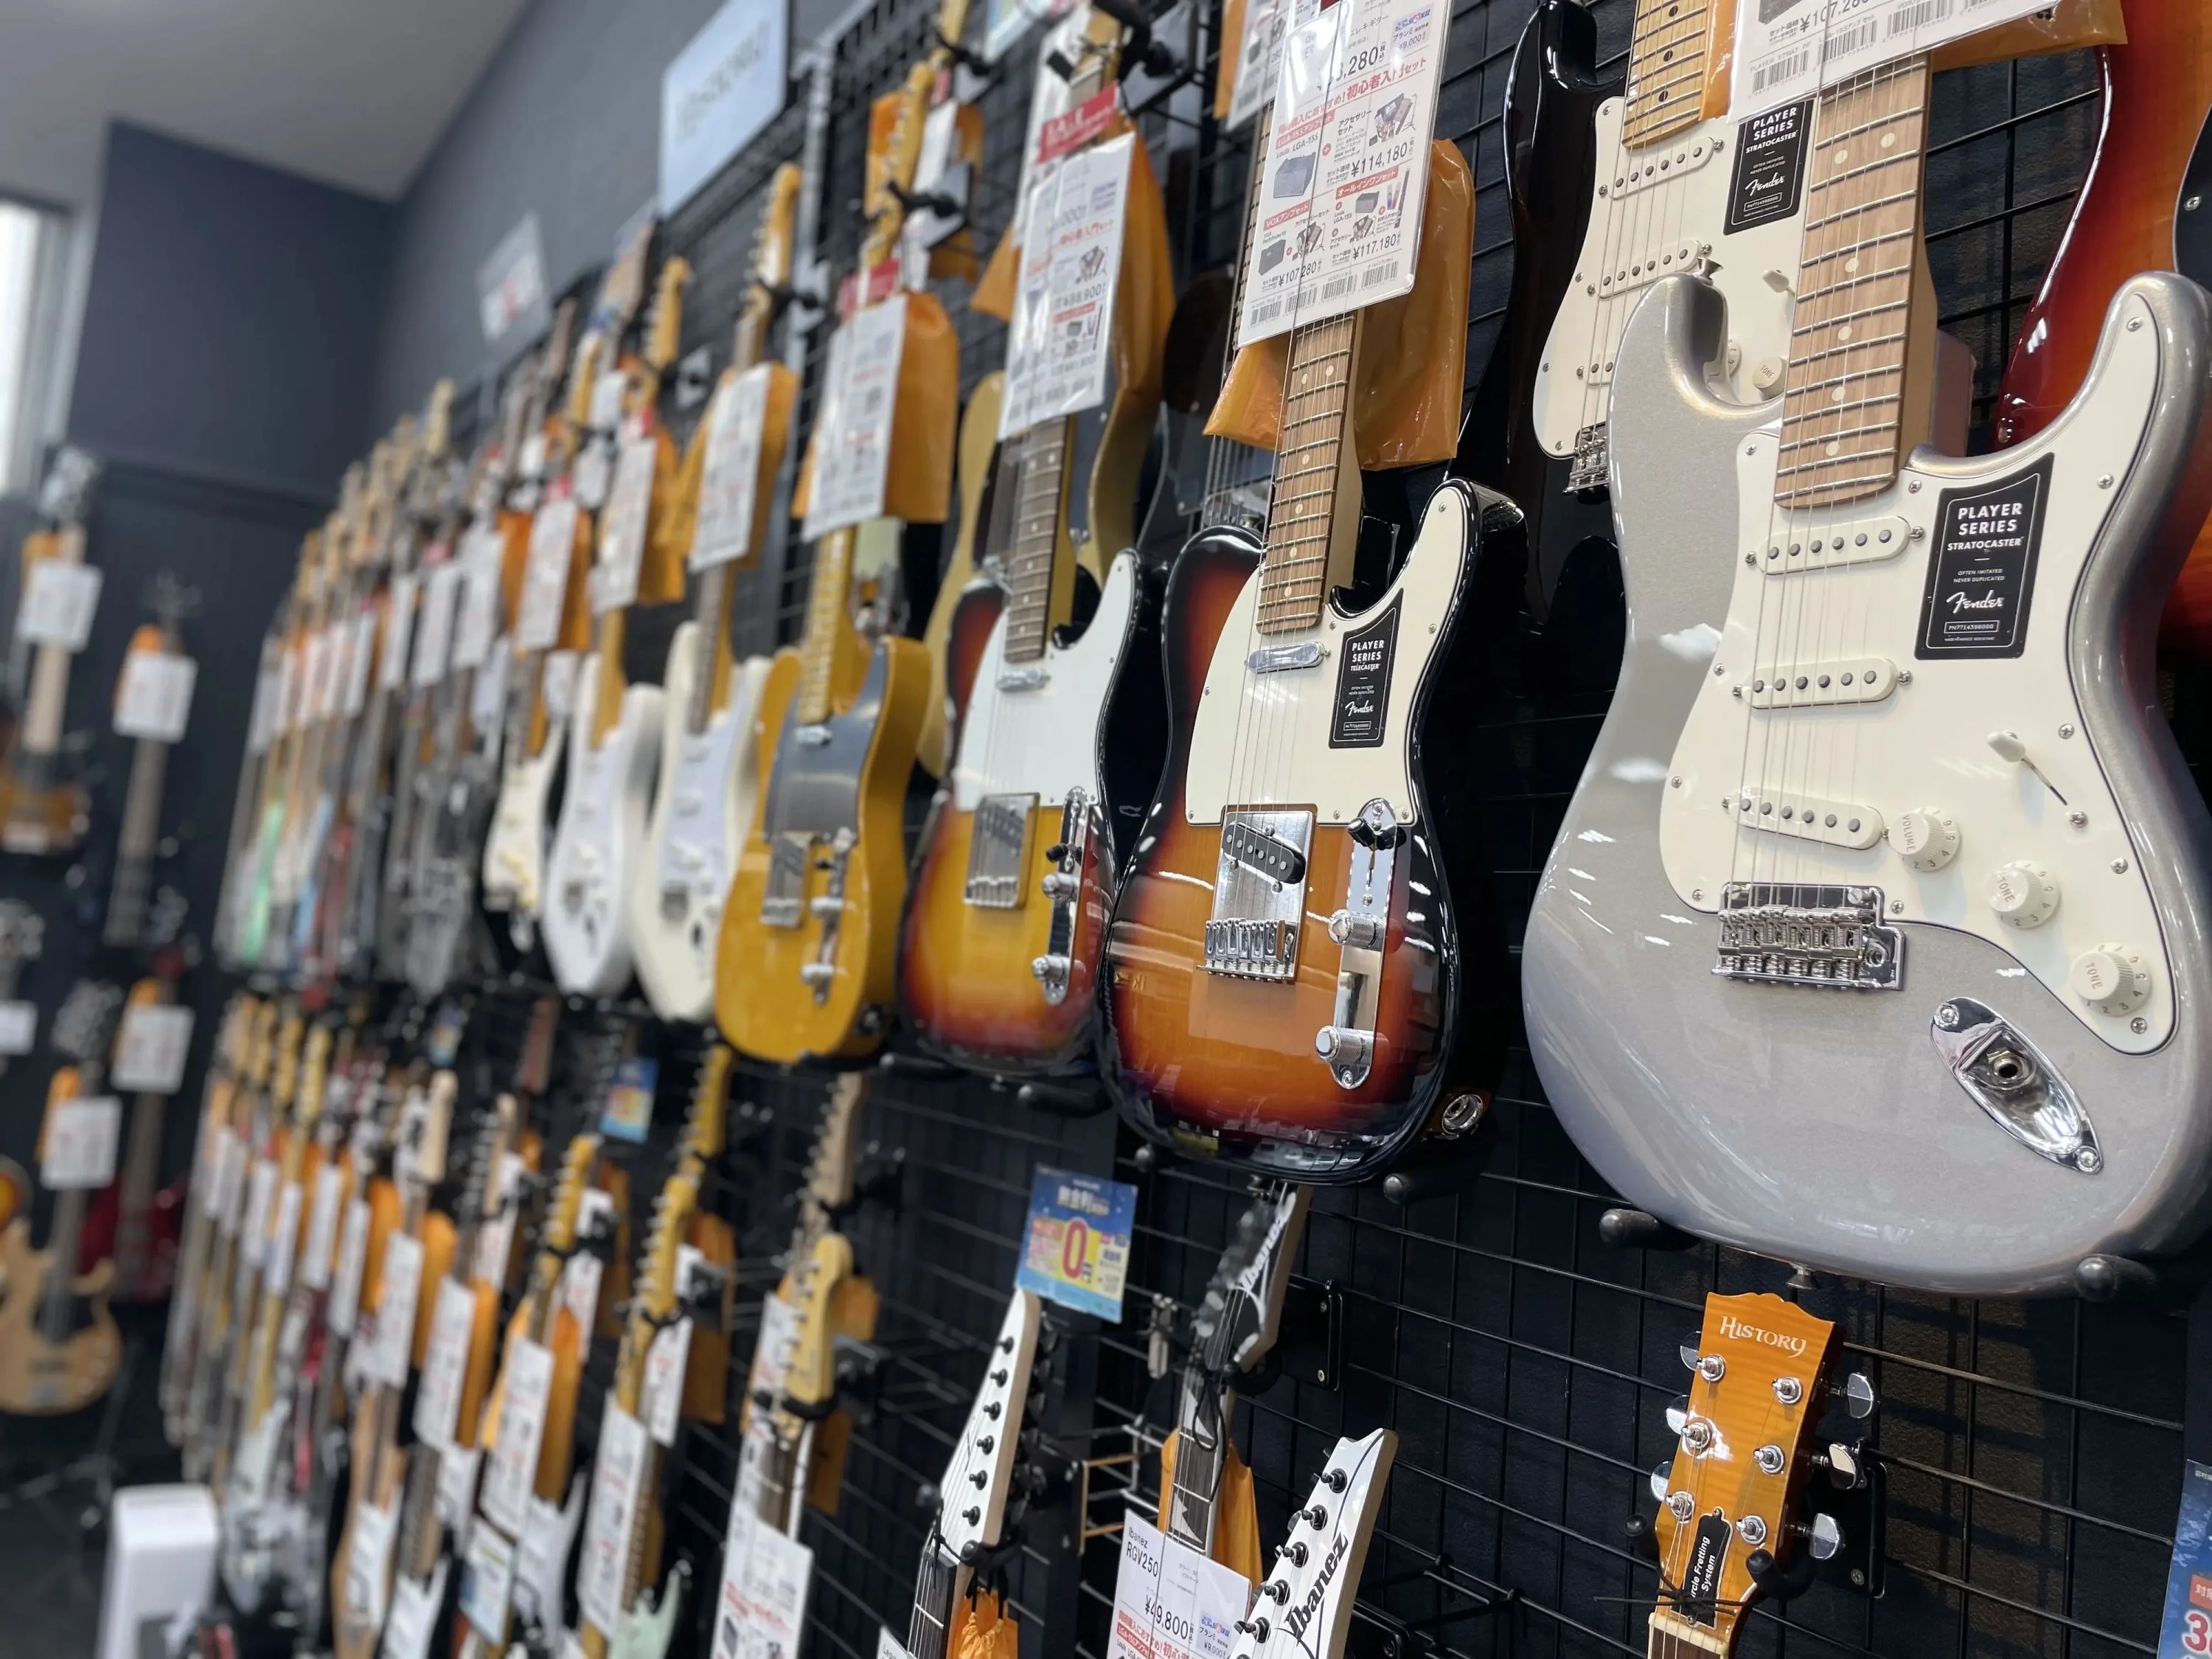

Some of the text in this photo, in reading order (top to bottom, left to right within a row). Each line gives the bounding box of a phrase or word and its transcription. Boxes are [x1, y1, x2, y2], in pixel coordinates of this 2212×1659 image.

[1338, 124, 1353, 136] セット
[1753, 107, 1797, 131] PLAYER
[1753, 119, 1794, 141] SERIES
[1745, 131, 1798, 154] STRATOCASTER
[1351, 142, 1408, 177] ¥114,180
[1745, 172, 1786, 197] Fender
[1352, 234, 1397, 260] ¥117,180
[1279, 262, 1317, 287] ¥107280
[1958, 502, 2023, 520] PLAYER
[1958, 519, 2017, 536] SERIES
[1947, 537, 2023, 552] STRATOCASTER
[1946, 589, 2006, 614] Fender
[1352, 639, 1385, 651] PLAYER
[1352, 651, 1382, 663] SERIES
[1350, 663, 1380, 672] TELECASTER
[1345, 700, 1374, 717] Fender
[1903, 815, 1916, 852] VOLUME
[1997, 877, 2015, 902] TONE
[2085, 961, 2103, 990] TONE
[1129, 1527, 1148, 1549] Ibanez
[1126, 1541, 1159, 1578] RGV250
[1691, 1536, 1710, 1599] ircle Fretting
[1701, 1554, 1716, 1592] System
[1284, 1531, 1349, 1644] Ibanez
[1145, 1594, 1189, 1641] ¥49,800
